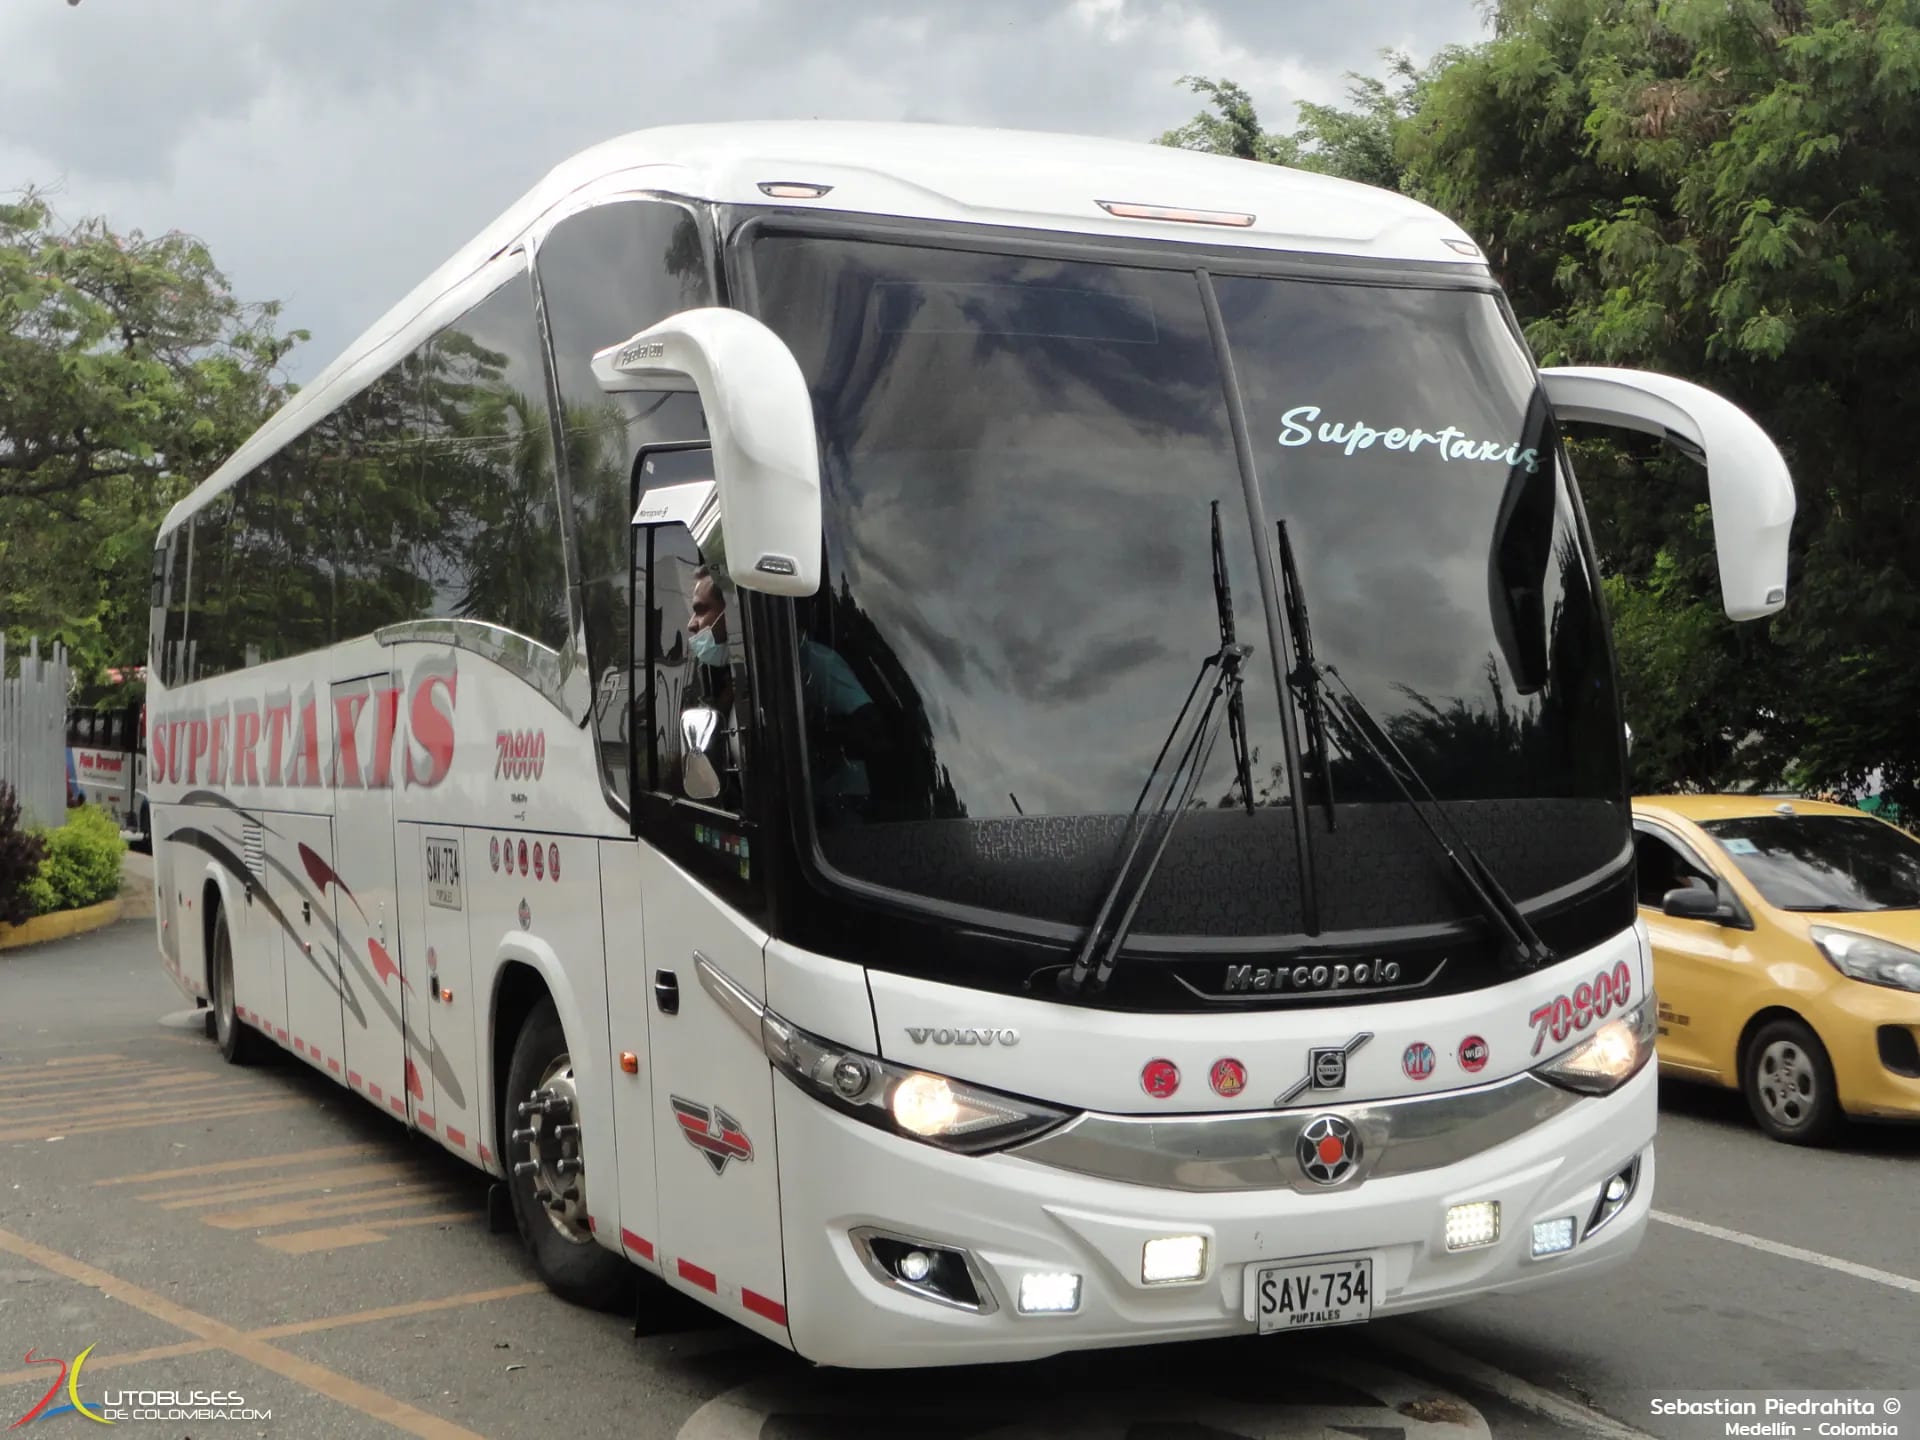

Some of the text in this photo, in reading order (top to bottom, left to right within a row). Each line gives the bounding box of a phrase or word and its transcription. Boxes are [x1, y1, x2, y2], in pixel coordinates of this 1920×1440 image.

[1278, 405, 1541, 474] Supertaxis
[150, 660, 458, 791] SUPERTAXIS
[494, 729, 546, 781] 70800
[1223, 959, 1401, 990] Marcopolo
[1529, 960, 1631, 1057] 70800
[903, 1027, 1021, 1047] VOLVO
[1289, 1310, 1341, 1325] PUPIALES
